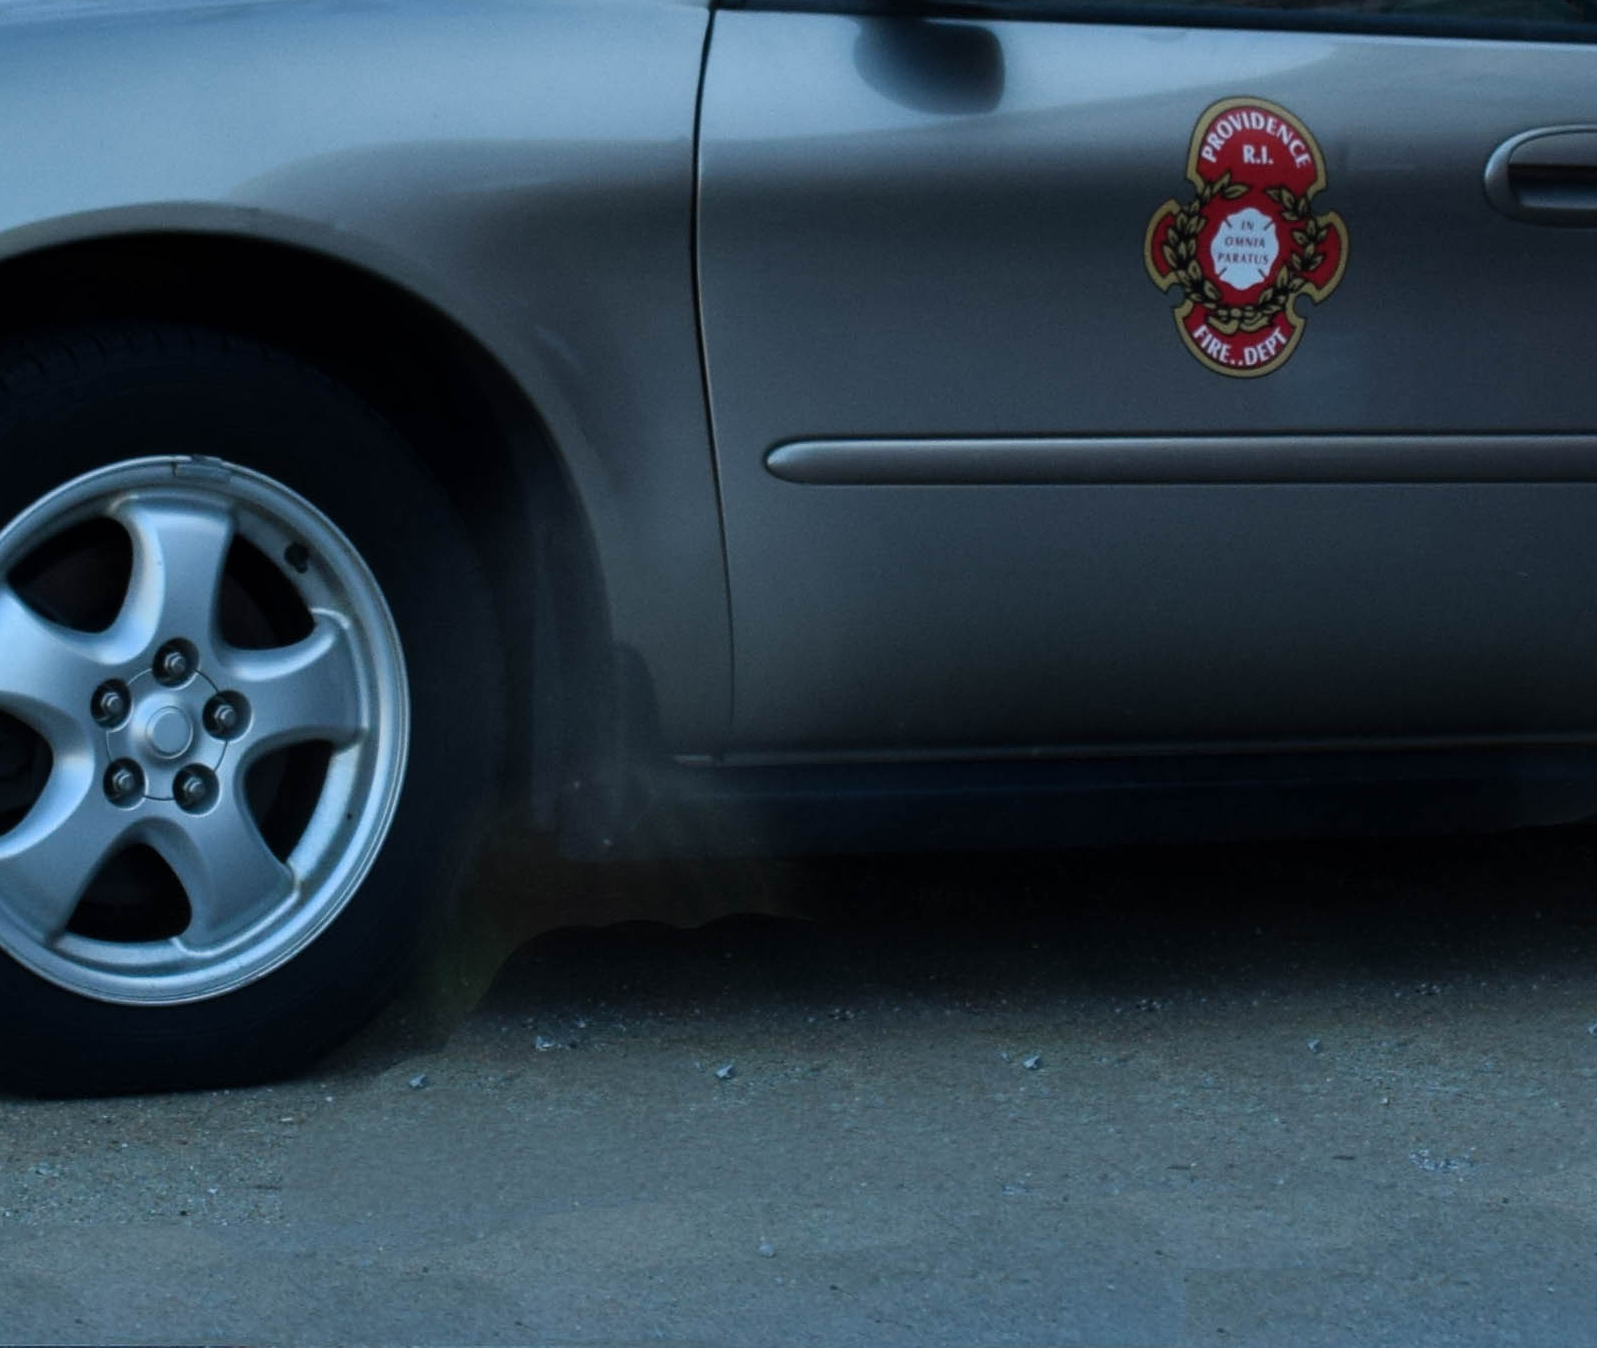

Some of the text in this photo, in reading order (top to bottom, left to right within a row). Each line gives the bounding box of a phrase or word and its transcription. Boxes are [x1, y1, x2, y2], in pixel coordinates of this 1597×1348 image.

[1202, 112, 1311, 168] PROVIDENCE
[1242, 144, 1274, 165] R.I.
[1241, 220, 1255, 231] IN
[1224, 236, 1266, 249] OMNIA
[1217, 252, 1269, 265] PARATUS
